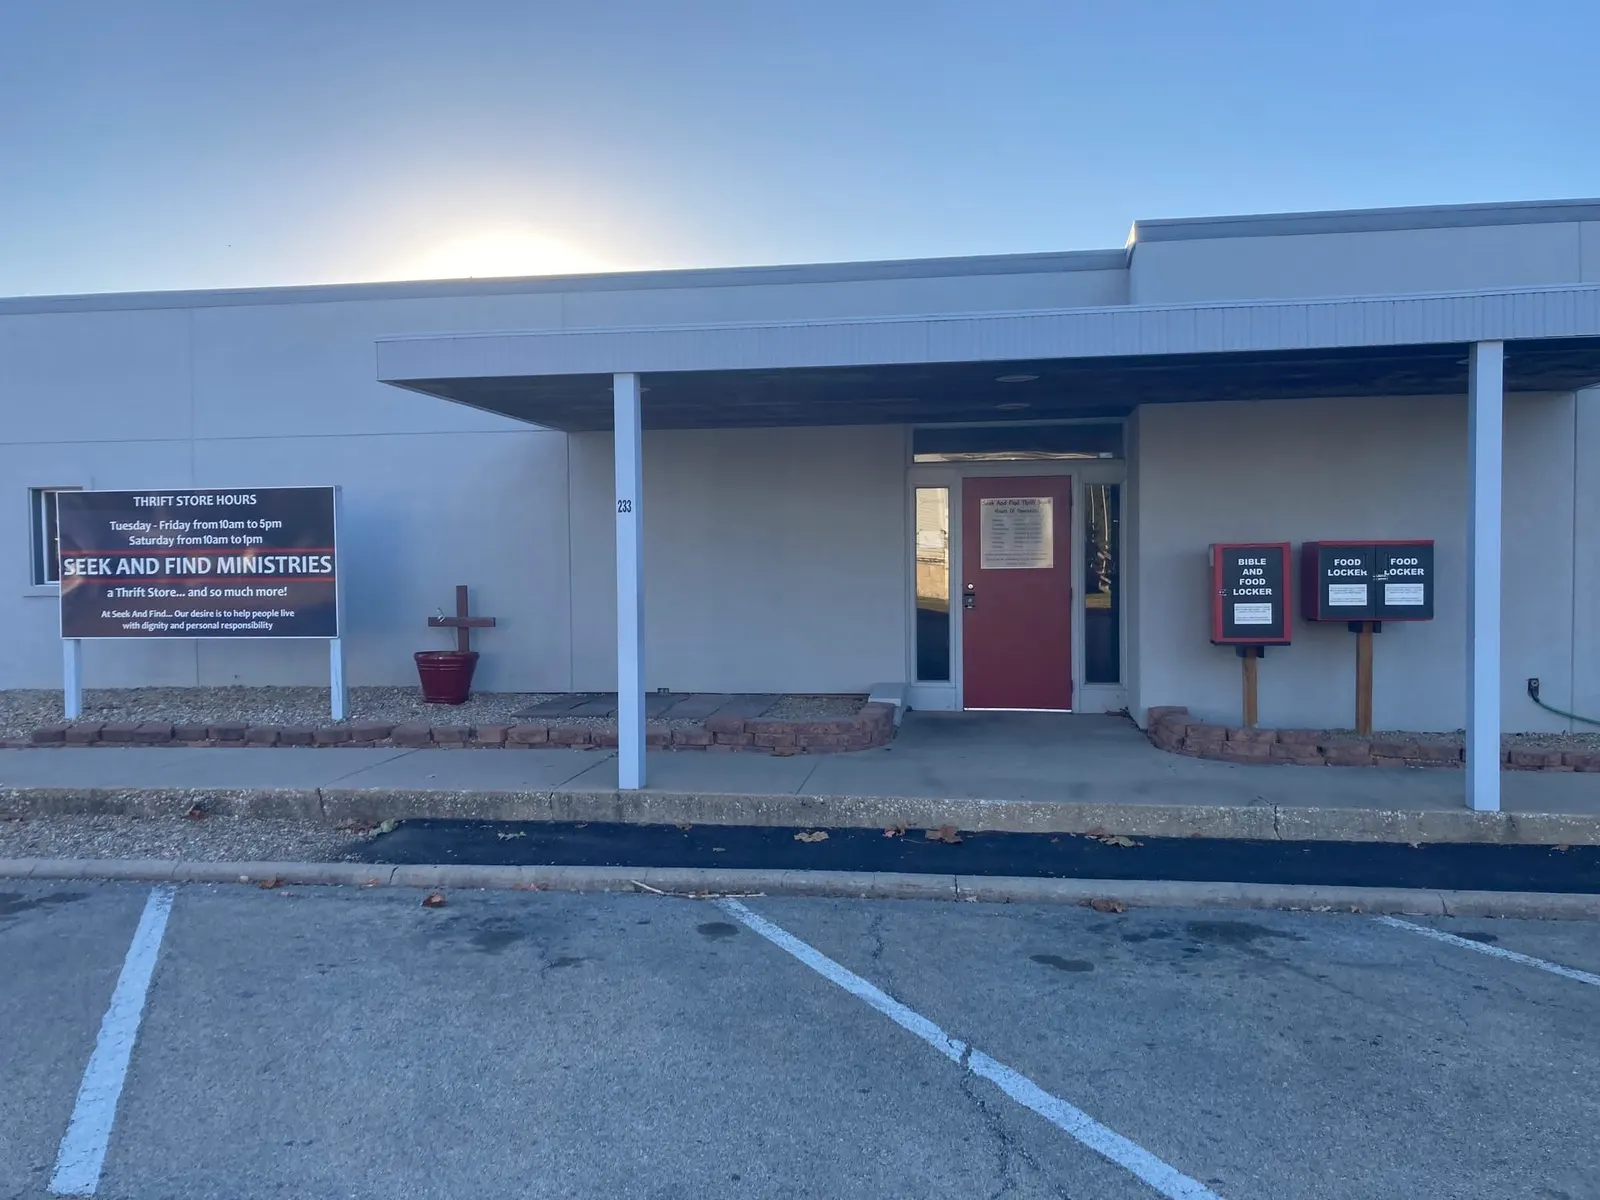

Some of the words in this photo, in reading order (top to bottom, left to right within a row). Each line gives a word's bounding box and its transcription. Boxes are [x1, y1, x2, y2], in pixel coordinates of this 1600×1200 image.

[133, 496, 174, 506] THRIFT
[176, 495, 214, 506] STORE
[216, 494, 257, 505] HOURS
[618, 500, 631, 513] 233
[110, 520, 151, 532] Tuesday
[159, 520, 190, 532] Friday
[192, 520, 218, 530] from
[219, 520, 244, 529] 10am
[247, 520, 257, 529] to
[259, 520, 282, 530] 5pm
[129, 535, 174, 547] Saturday
[176, 535, 202, 545] from
[203, 535, 228, 544] 10am
[231, 536, 242, 544] to
[243, 535, 263, 546] 1pm
[64, 558, 112, 576] SEEK
[116, 557, 159, 575] AND
[165, 557, 211, 574] FIND
[216, 556, 332, 574] MINISTRIES
[115, 587, 146, 598] Thrift
[148, 587, 185, 598] Store...
[188, 587, 207, 597] and
[224, 587, 253, 597] much
[256, 586, 287, 597] more!
[234, 609, 250, 619] help
[252, 609, 279, 618] people
[142, 622, 168, 631] dignity
[186, 622, 220, 631] personal
[221, 621, 273, 631] responsibility
